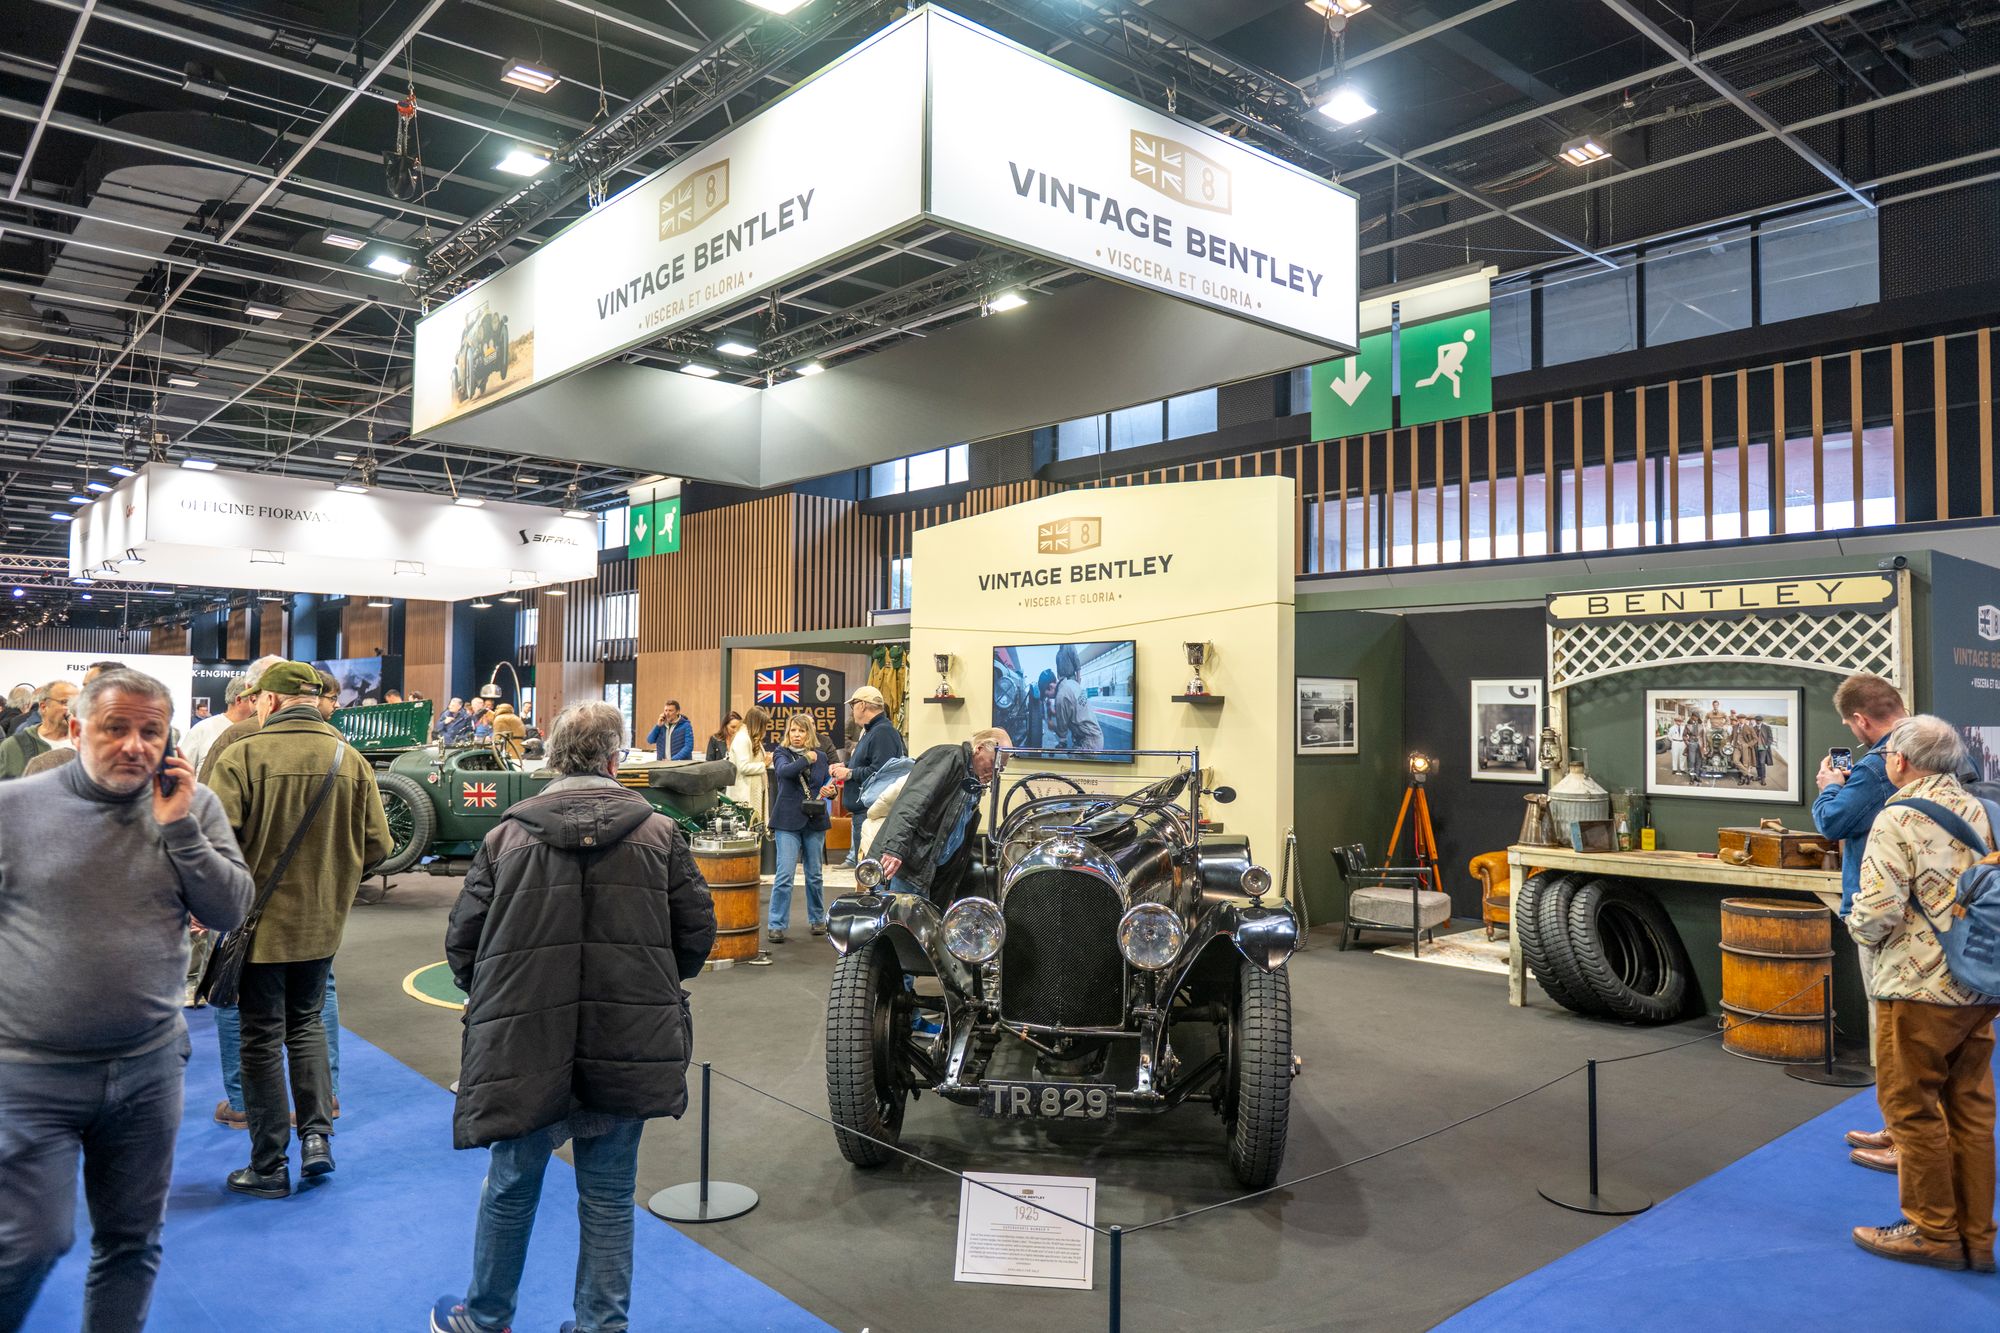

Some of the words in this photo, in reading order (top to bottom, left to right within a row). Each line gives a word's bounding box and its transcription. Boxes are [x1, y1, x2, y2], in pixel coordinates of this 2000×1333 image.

[1008, 161, 1172, 248] VINTAGE
[1186, 226, 1324, 298] BENTLEY
[597, 253, 685, 320] VINTAGE
[694, 188, 815, 273] BENTLEY
[1107, 247, 1173, 285] VISCERA
[1179, 272, 1196, 291] ET
[1202, 279, 1252, 309] GLORIA
[644, 301, 685, 329] VISCERA
[688, 290, 701, 310] ET
[705, 271, 745, 300] GLORIA
[532, 534, 578, 546] SIFRAL
[978, 567, 1062, 592] VINTAGE
[1070, 554, 1173, 583] BENTLEY
[1024, 595, 1062, 608] VISCERA
[1065, 595, 1077, 605] ET
[1080, 591, 1115, 604] GLORIA
[1587, 581, 1843, 615] BENTLEY
[1953, 647, 1989, 668] VINTAGE
[815, 673, 831, 702] 8
[765, 706, 836, 719] VINTAGE
[766, 719, 837, 731] BEEY
[988, 1085, 1031, 1115] TR
[1040, 1087, 1108, 1118] 829
[1014, 1205, 1039, 1221] 1925
